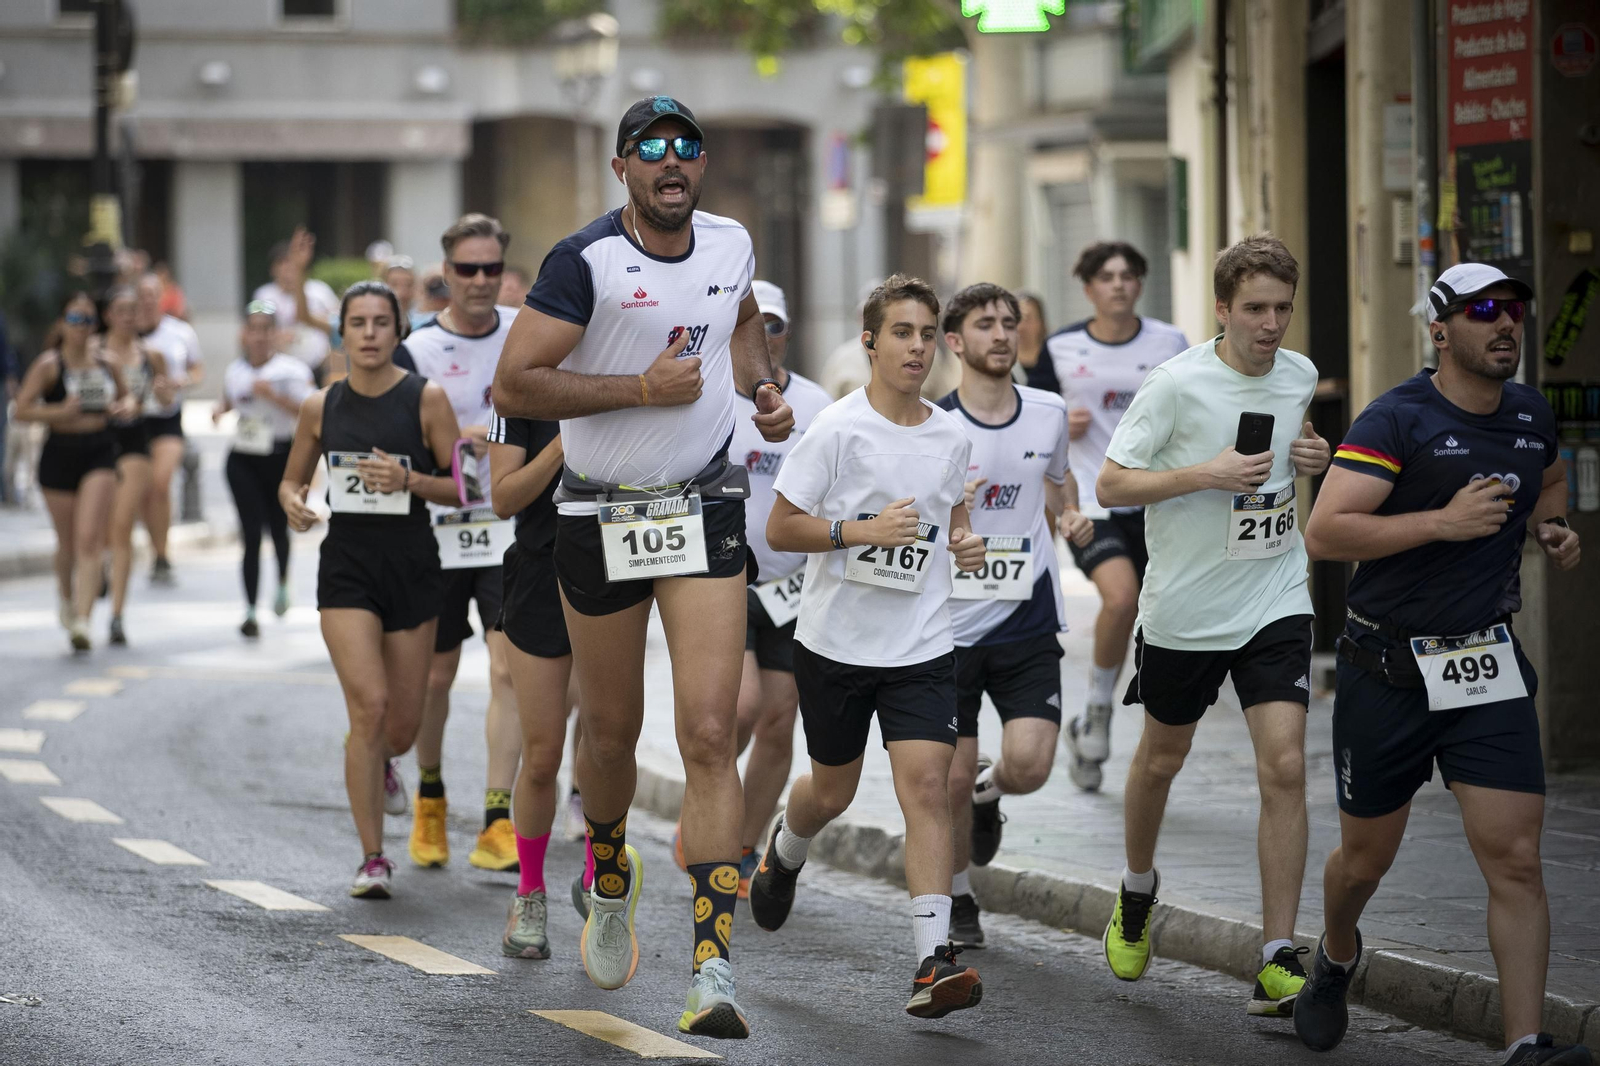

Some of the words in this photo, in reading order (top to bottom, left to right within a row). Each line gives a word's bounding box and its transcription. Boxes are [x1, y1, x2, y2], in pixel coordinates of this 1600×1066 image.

[1455, 33, 1494, 58] Productos
[1496, 29, 1506, 54] de
[1463, 63, 1517, 91] Alimentación
[621, 300, 659, 309] Santander
[1434, 448, 1470, 456] Santander
[646, 499, 689, 516] GRANADA
[1237, 507, 1294, 541] 2166
[458, 528, 491, 549] 94
[622, 525, 686, 556] 105
[1265, 541, 1276, 550] LUIS
[629, 554, 686, 568] SIMPLEMENTECOYO
[857, 544, 929, 572] 2167
[873, 568, 916, 583] COQUITOLENTITO
[1352, 613, 1380, 631] Kalenji
[1442, 653, 1499, 685] 499
[1466, 686, 1488, 697] CARLOS
